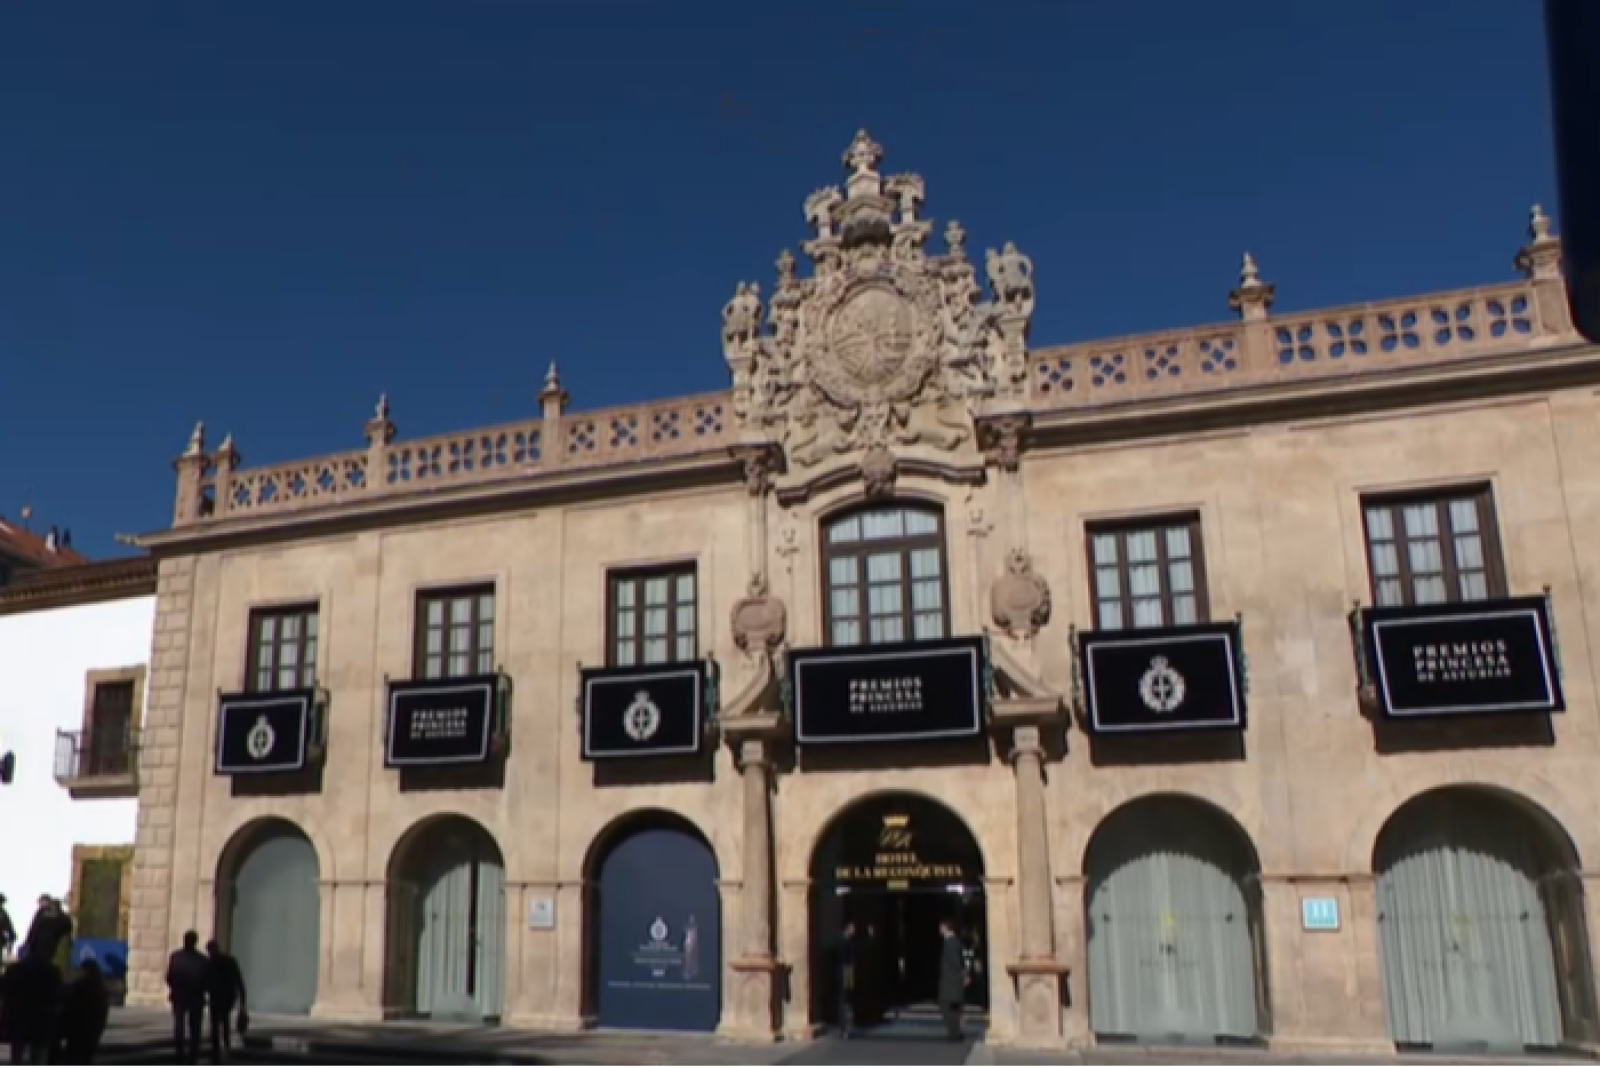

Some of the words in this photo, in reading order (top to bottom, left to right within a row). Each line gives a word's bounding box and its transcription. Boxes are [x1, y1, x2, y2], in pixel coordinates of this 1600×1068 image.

[1412, 639, 1506, 657] PREMIOS
[1415, 653, 1509, 671] PRINCESA
[849, 677, 922, 690] PREMIOS
[849, 690, 922, 703] PRINCESA
[875, 852, 917, 863] HOTEL
